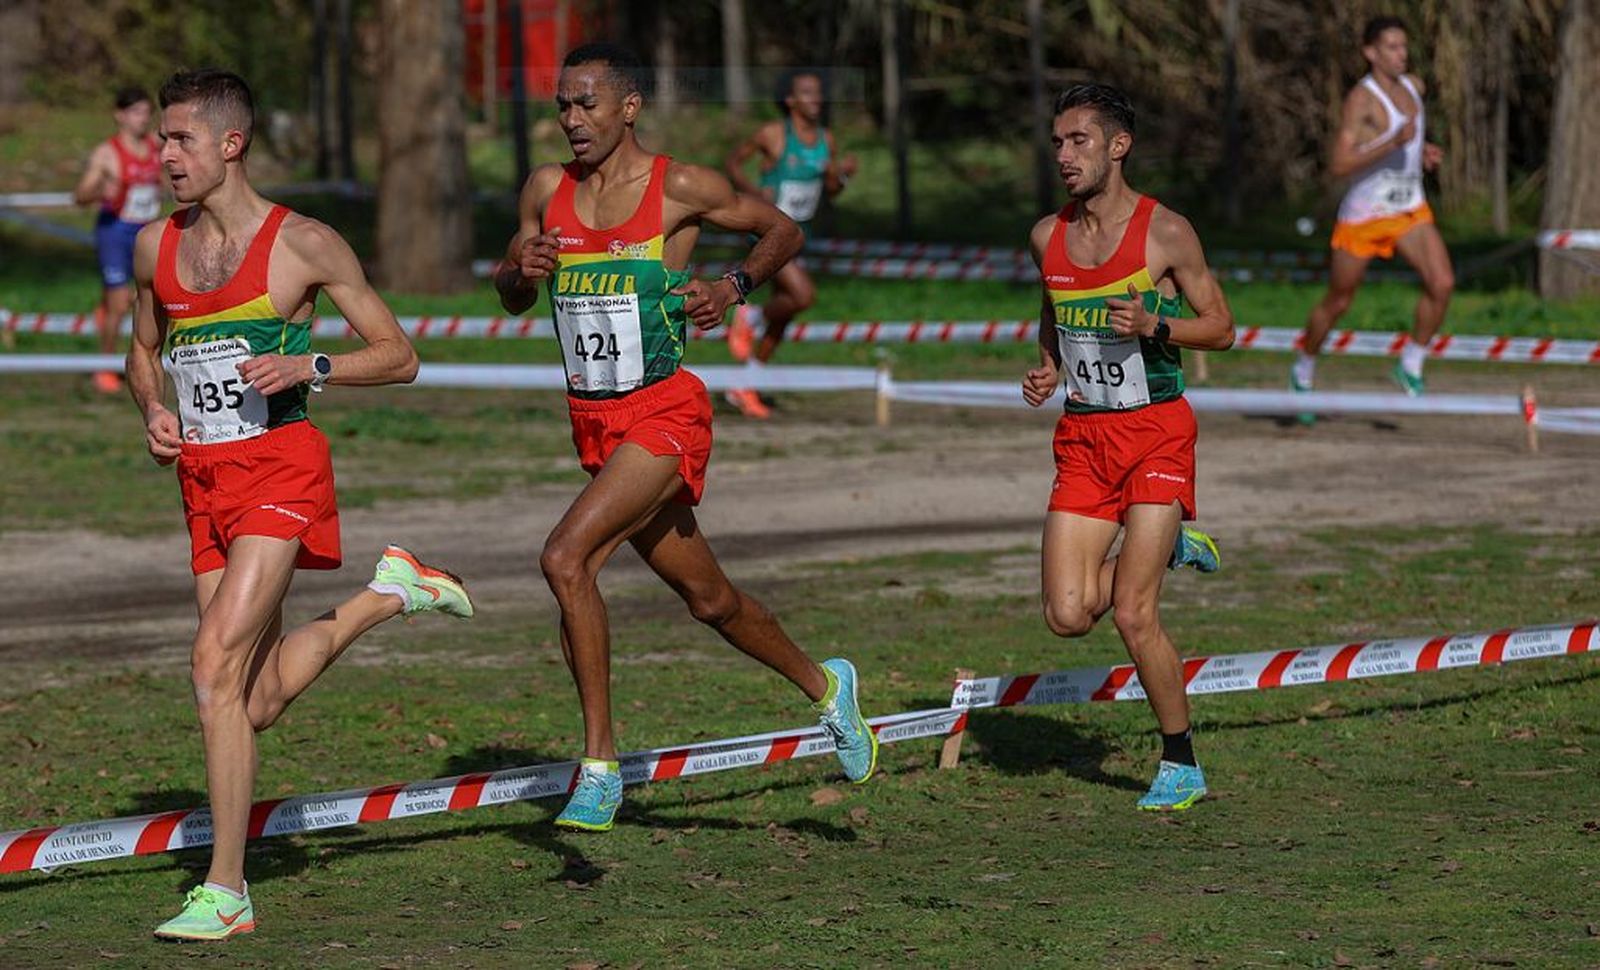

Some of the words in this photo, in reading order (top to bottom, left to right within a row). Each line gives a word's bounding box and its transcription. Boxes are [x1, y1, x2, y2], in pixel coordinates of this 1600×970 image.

[556, 271, 635, 295] BIKILA
[1054, 305, 1112, 328] BIKIL
[574, 332, 622, 362] 424
[1076, 359, 1126, 387] 419
[192, 378, 244, 414] 435
